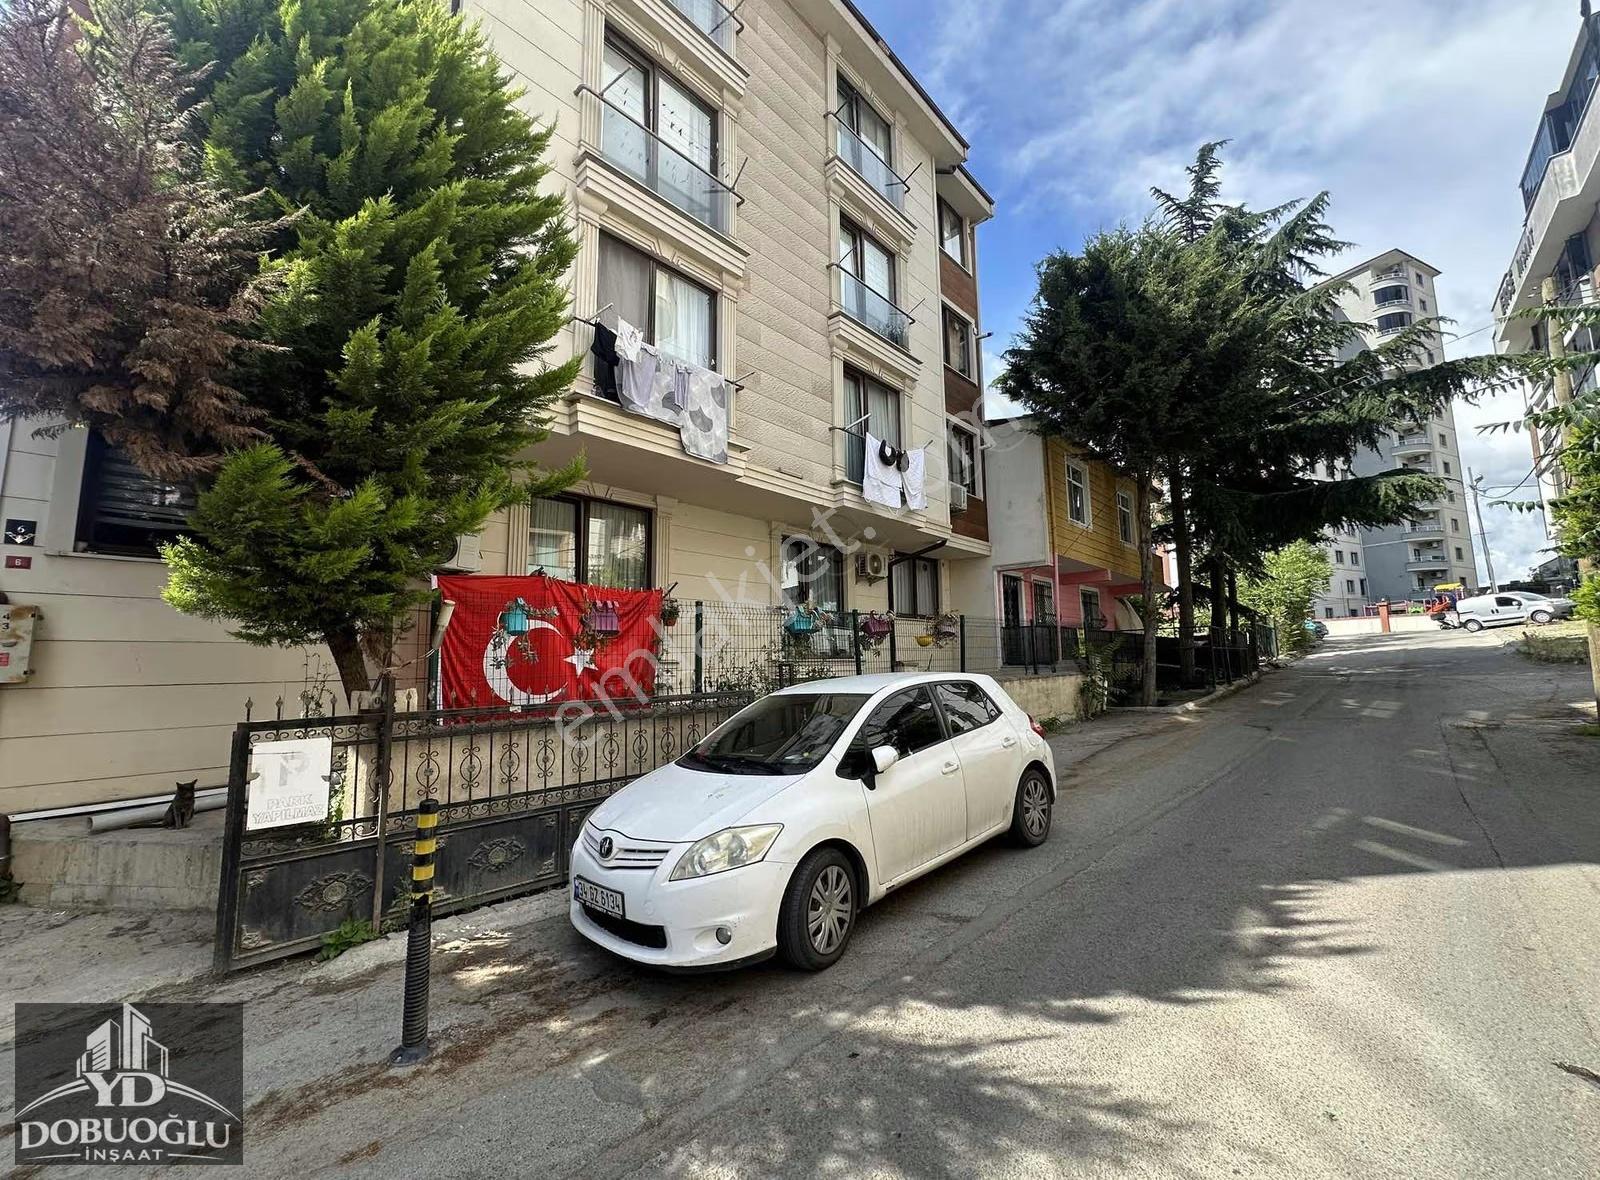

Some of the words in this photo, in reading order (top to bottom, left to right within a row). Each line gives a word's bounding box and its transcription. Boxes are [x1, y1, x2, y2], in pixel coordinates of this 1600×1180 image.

[17, 525, 25, 534] 6
[266, 793, 313, 810] PARK
[252, 803, 325, 825] YAPILMAZ
[578, 881, 588, 899] 34
[600, 890, 621, 912] 6134
